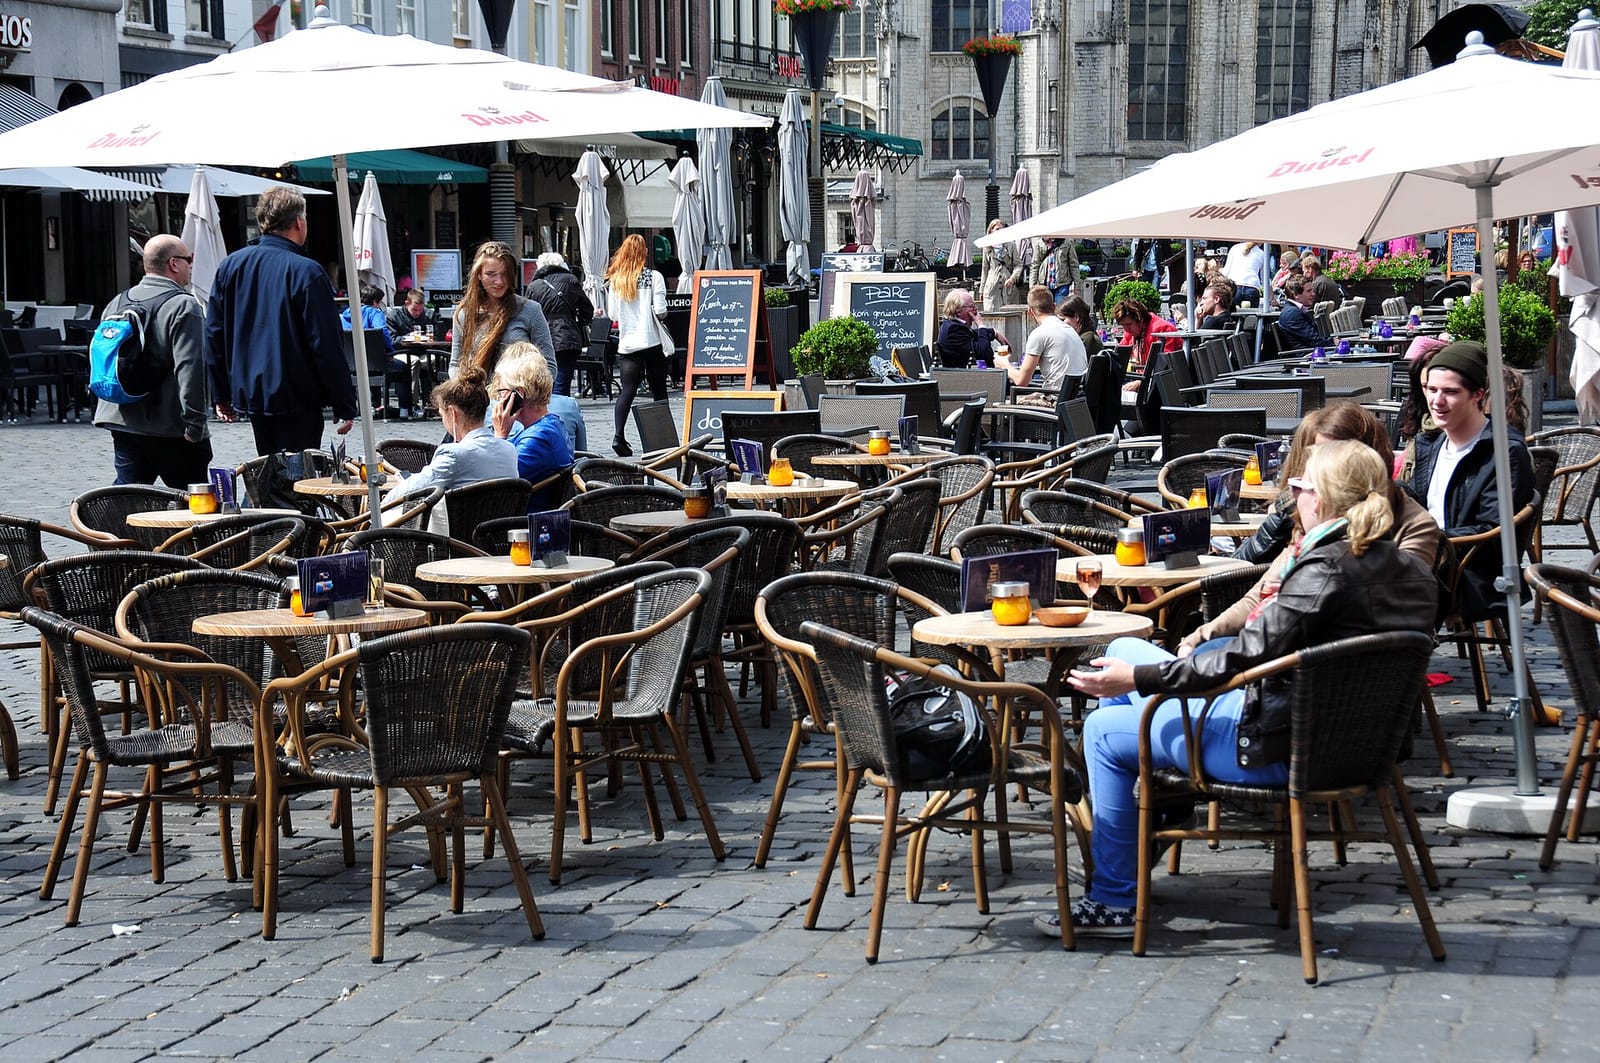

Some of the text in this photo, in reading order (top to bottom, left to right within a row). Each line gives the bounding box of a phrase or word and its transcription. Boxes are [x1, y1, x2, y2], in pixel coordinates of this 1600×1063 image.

[778, 55, 801, 78] SUMO
[461, 110, 549, 126] Duvel
[1266, 147, 1376, 179] Duvel
[698, 408, 723, 430] do
